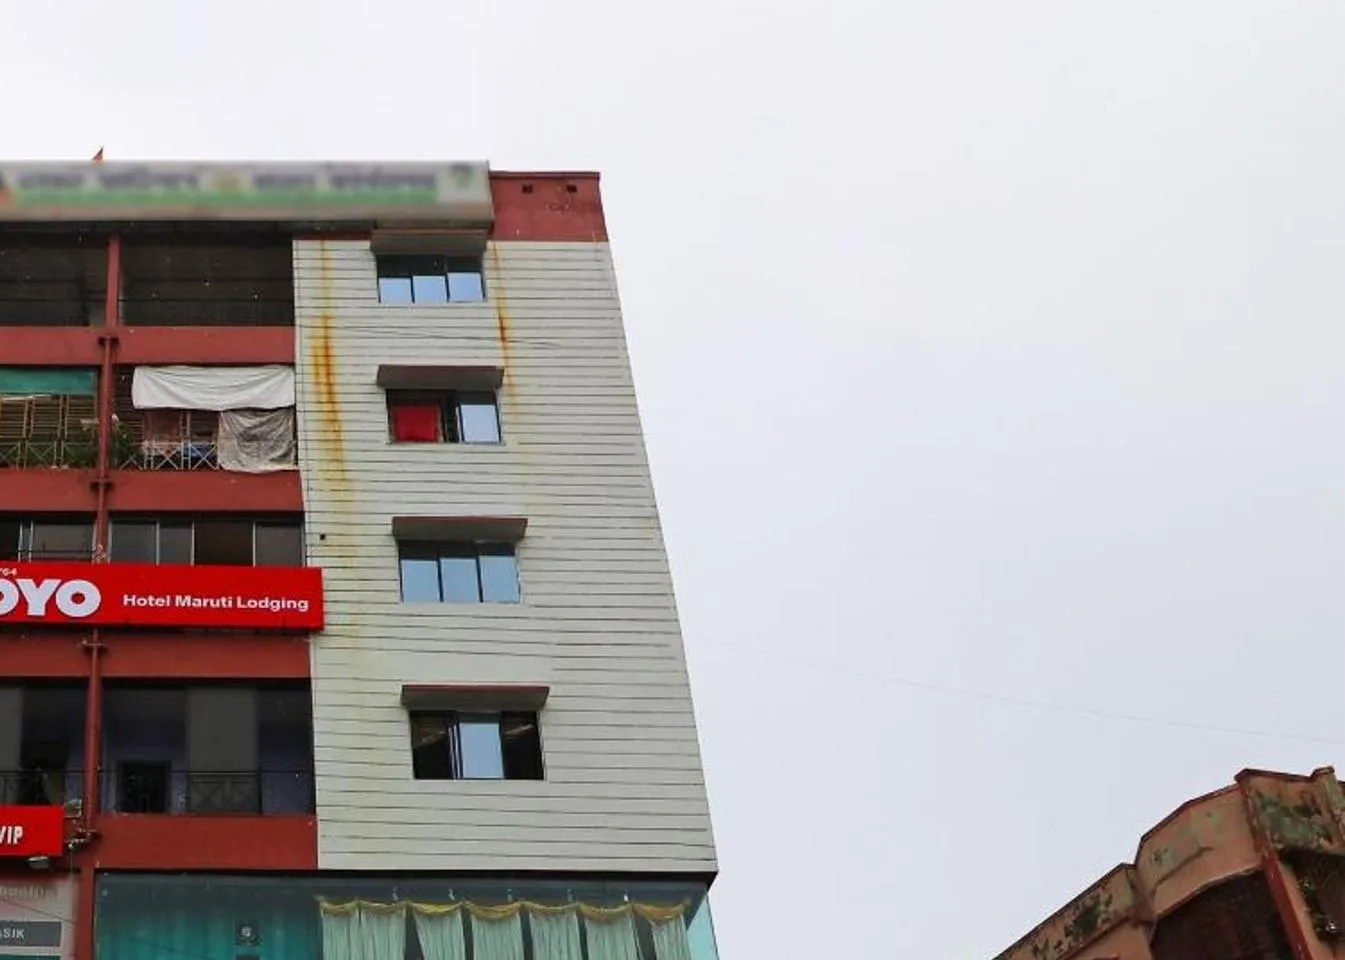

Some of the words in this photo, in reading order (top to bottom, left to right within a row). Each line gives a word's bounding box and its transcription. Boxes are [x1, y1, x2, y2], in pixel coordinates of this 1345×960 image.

[123, 594, 171, 608] Hotel
[175, 595, 233, 609] Maruti
[236, 596, 309, 613] Lodging
